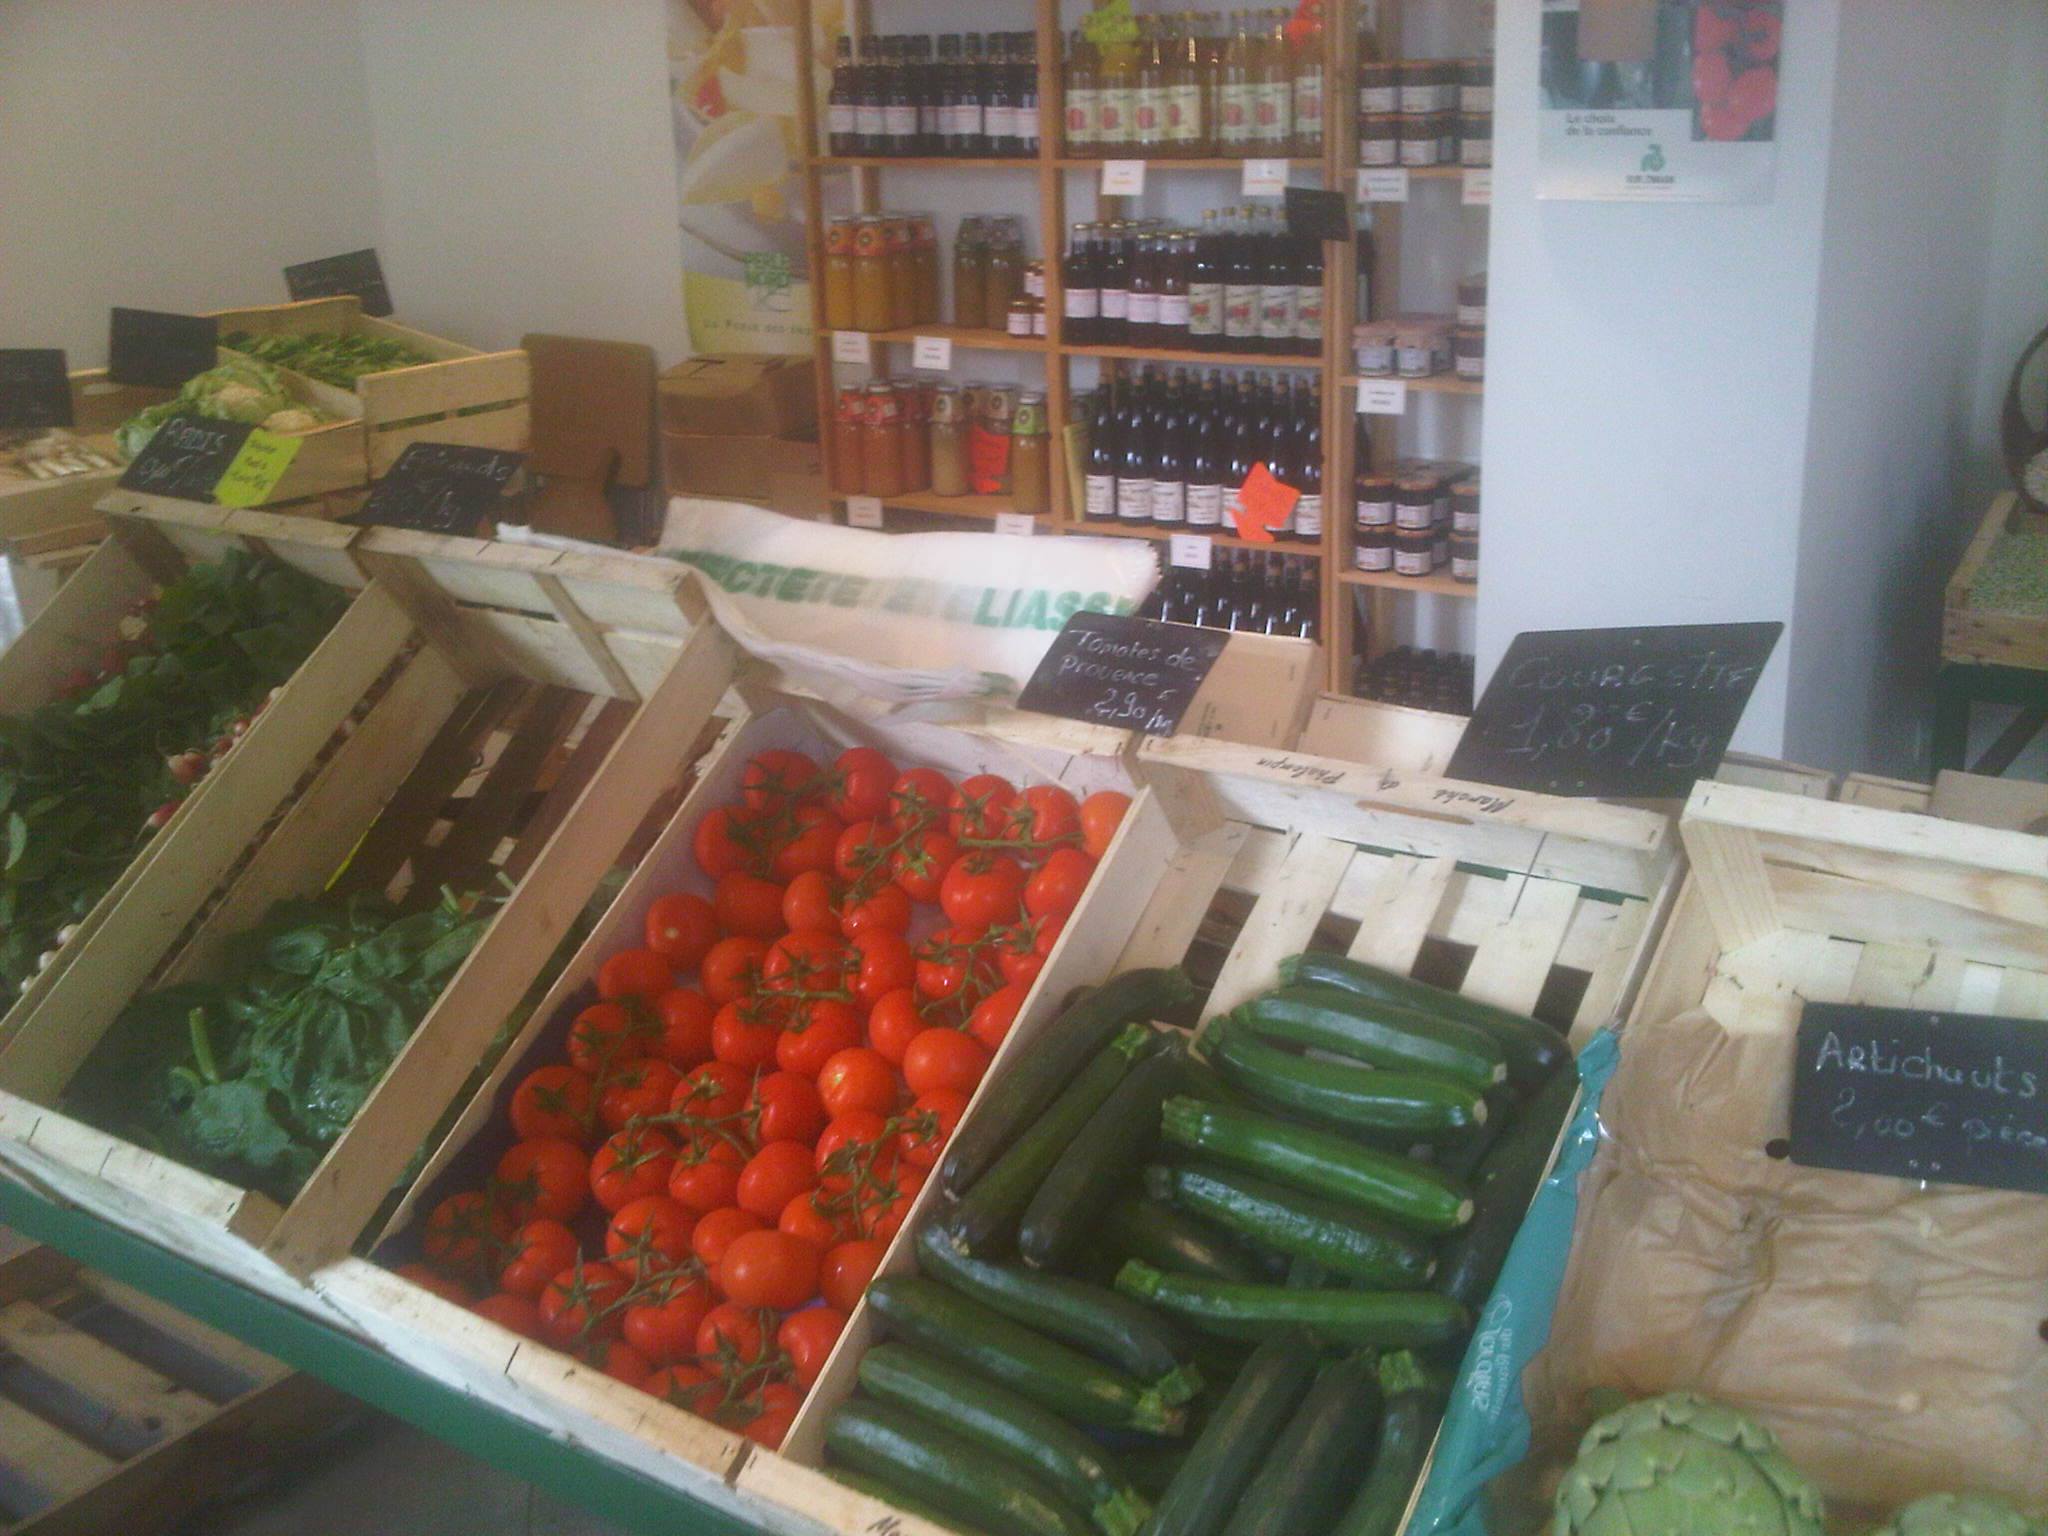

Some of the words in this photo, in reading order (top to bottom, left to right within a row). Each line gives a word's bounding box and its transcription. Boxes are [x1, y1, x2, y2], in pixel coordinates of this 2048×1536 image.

[1067, 629, 1161, 662] Tomates
[1164, 647, 1197, 672] de
[1057, 654, 1160, 688] Provence
